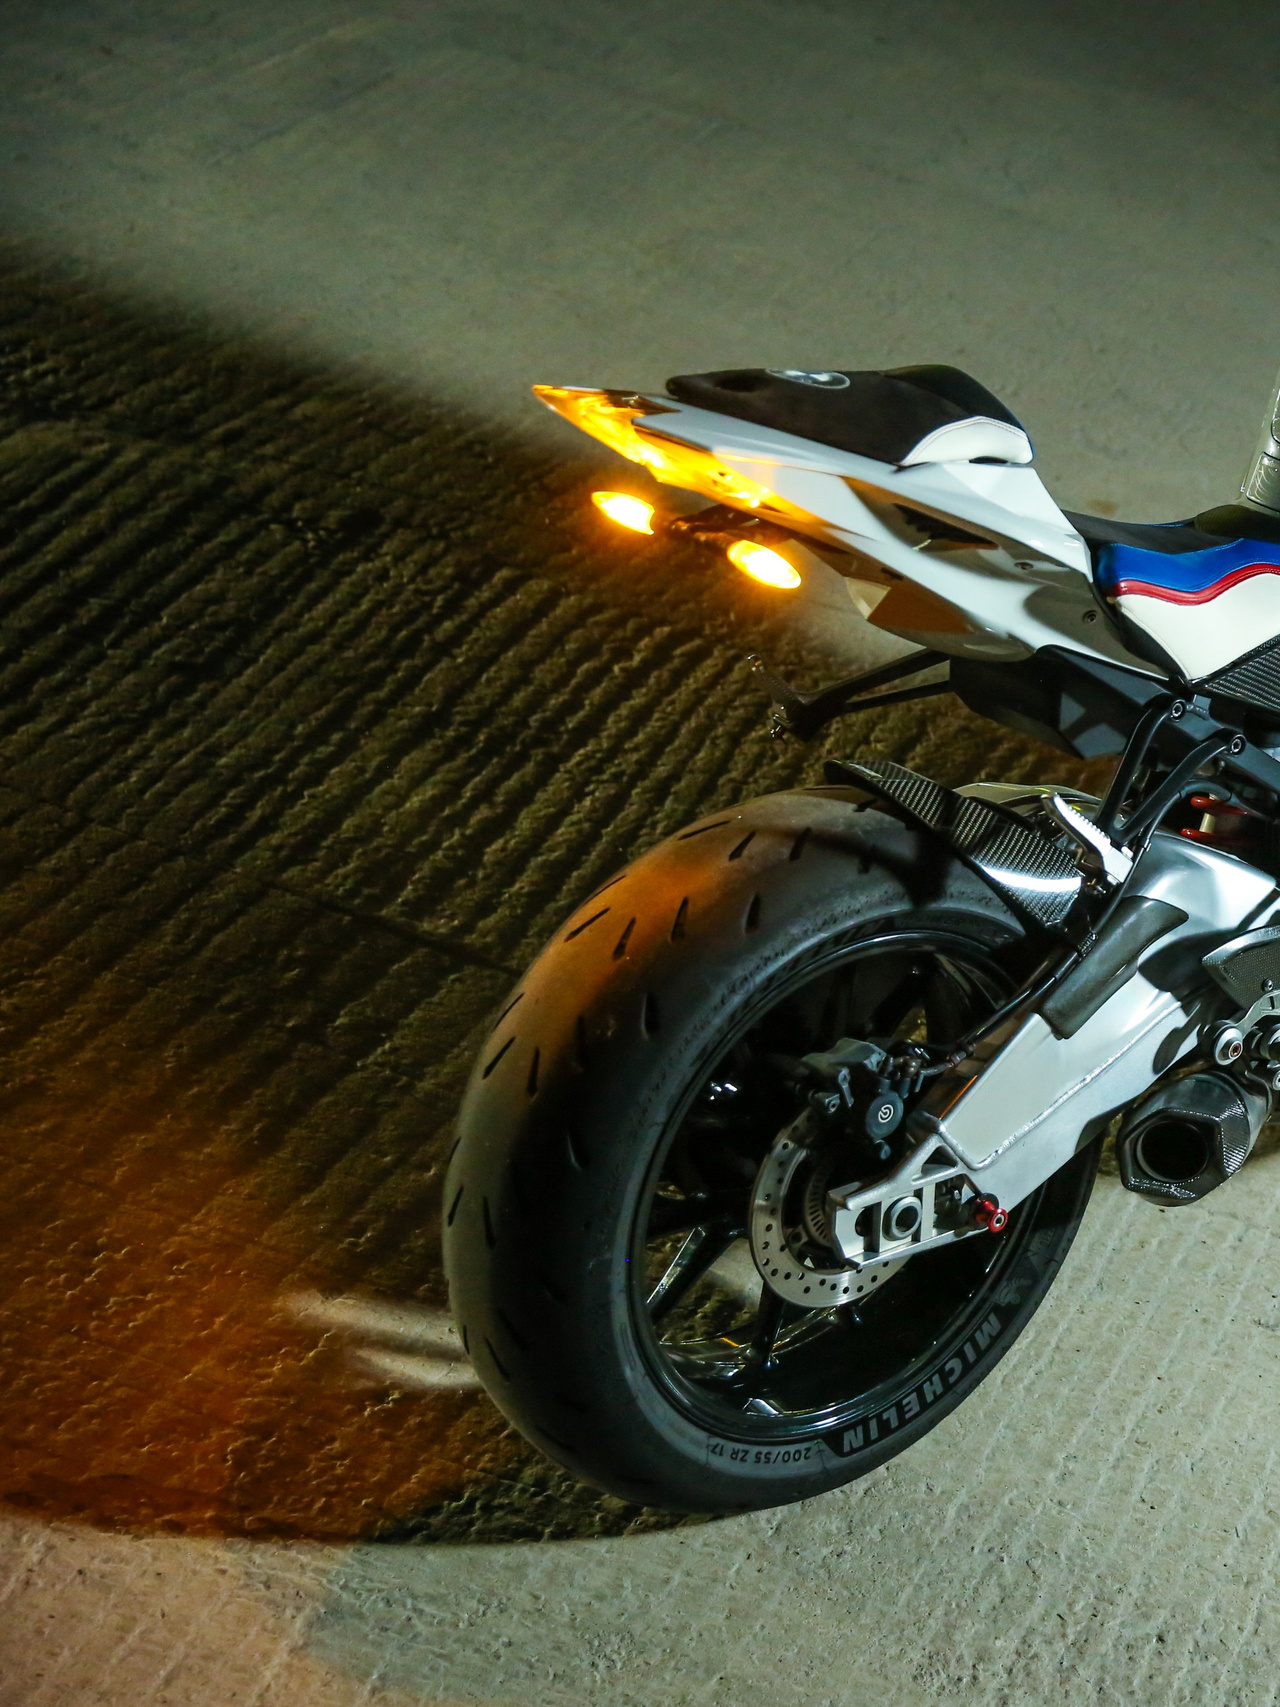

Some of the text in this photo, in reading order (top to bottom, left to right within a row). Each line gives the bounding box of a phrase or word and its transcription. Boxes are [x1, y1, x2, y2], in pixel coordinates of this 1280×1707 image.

[843, 1312, 1002, 1453] MICHELIN
[710, 1443, 812, 1464] 200/55 ZR 17
